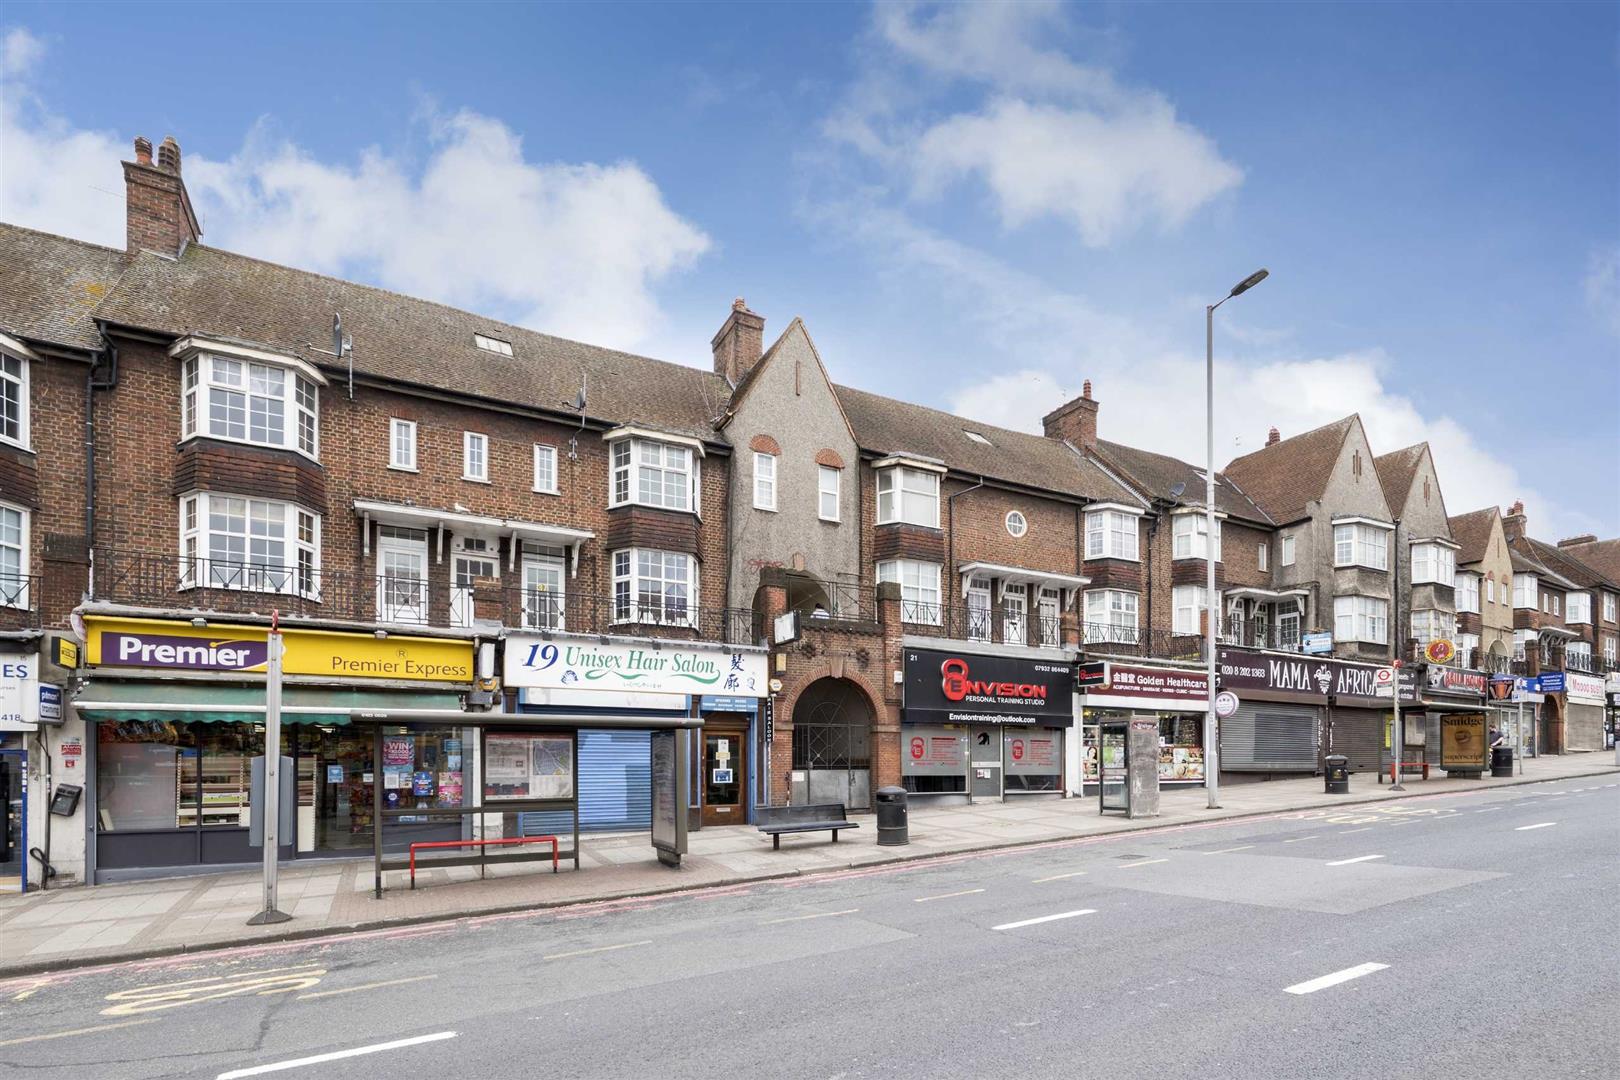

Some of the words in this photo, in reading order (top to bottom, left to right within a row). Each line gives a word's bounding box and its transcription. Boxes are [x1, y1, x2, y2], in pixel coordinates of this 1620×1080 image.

[119, 636, 250, 667] Premier
[521, 643, 559, 672] 19
[565, 646, 622, 669] Unisex
[626, 649, 668, 671] Hair
[671, 652, 715, 674] Salon
[910, 654, 918, 662] 21
[332, 656, 399, 673] Premier
[405, 660, 467, 678] Express
[1234, 665, 1239, 677] 8
[1268, 659, 1312, 691] MAMA
[1137, 674, 1165, 686] Golden
[1167, 677, 1208, 689] Healthcare
[965, 695, 996, 704] PERSONAL
[997, 696, 1024, 705] TRAINING
[1024, 698, 1045, 706] STUDIO
[949, 712, 1036, 724] Envisiontraining@outlook.com
[1443, 716, 1483, 728] Smidge
[388, 742, 409, 750] WIN
